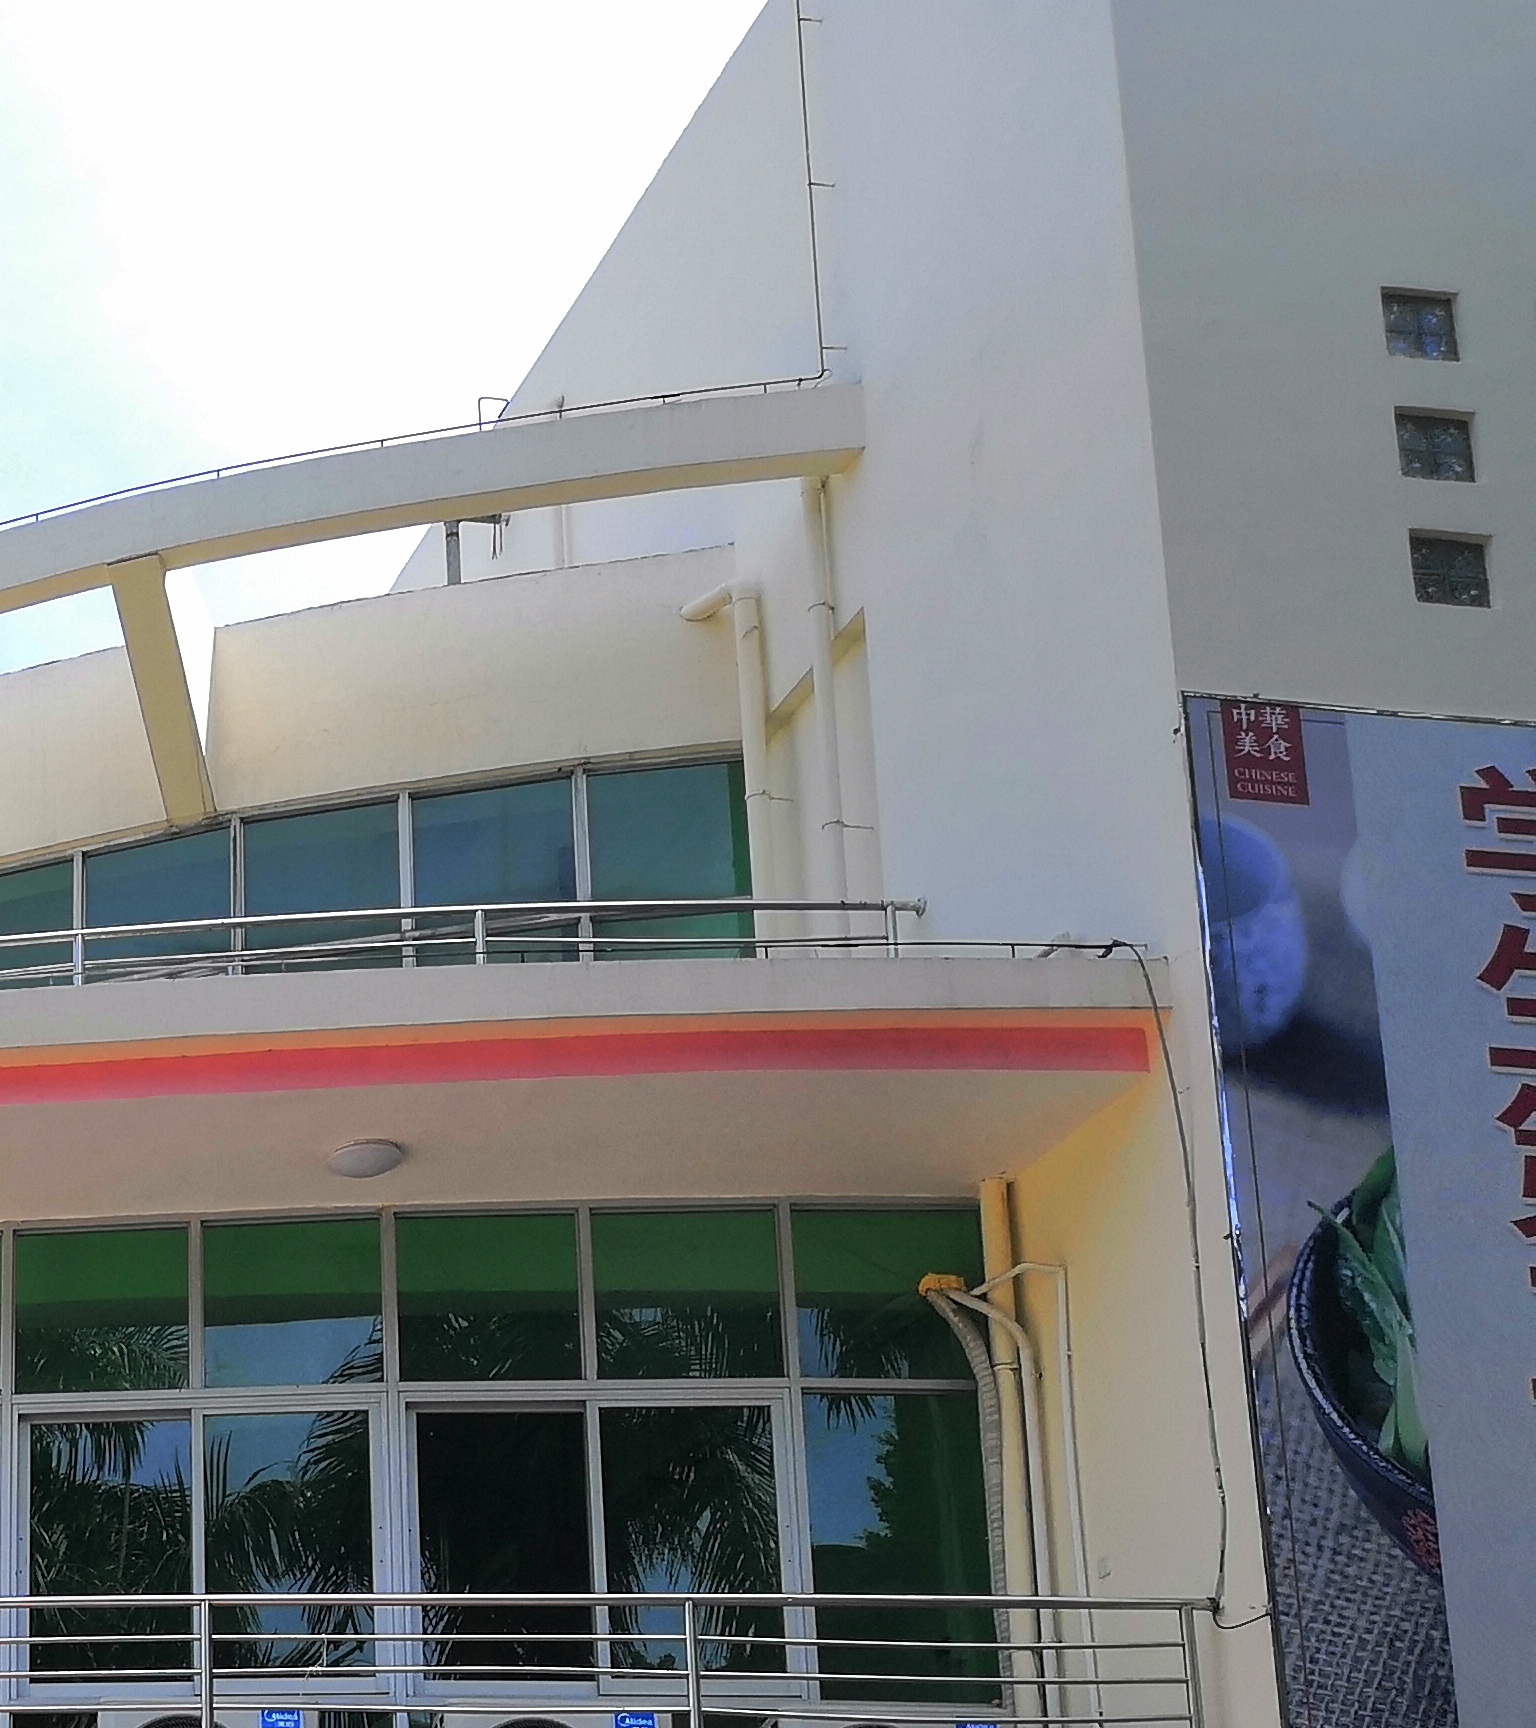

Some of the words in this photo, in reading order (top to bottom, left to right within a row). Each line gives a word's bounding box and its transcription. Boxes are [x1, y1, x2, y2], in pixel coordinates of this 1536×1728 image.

[1232, 704, 1289, 733] 中華
[1234, 731, 1292, 761] 美食
[1234, 768, 1297, 783] CHINESE
[1237, 782, 1296, 797] CUISINE
